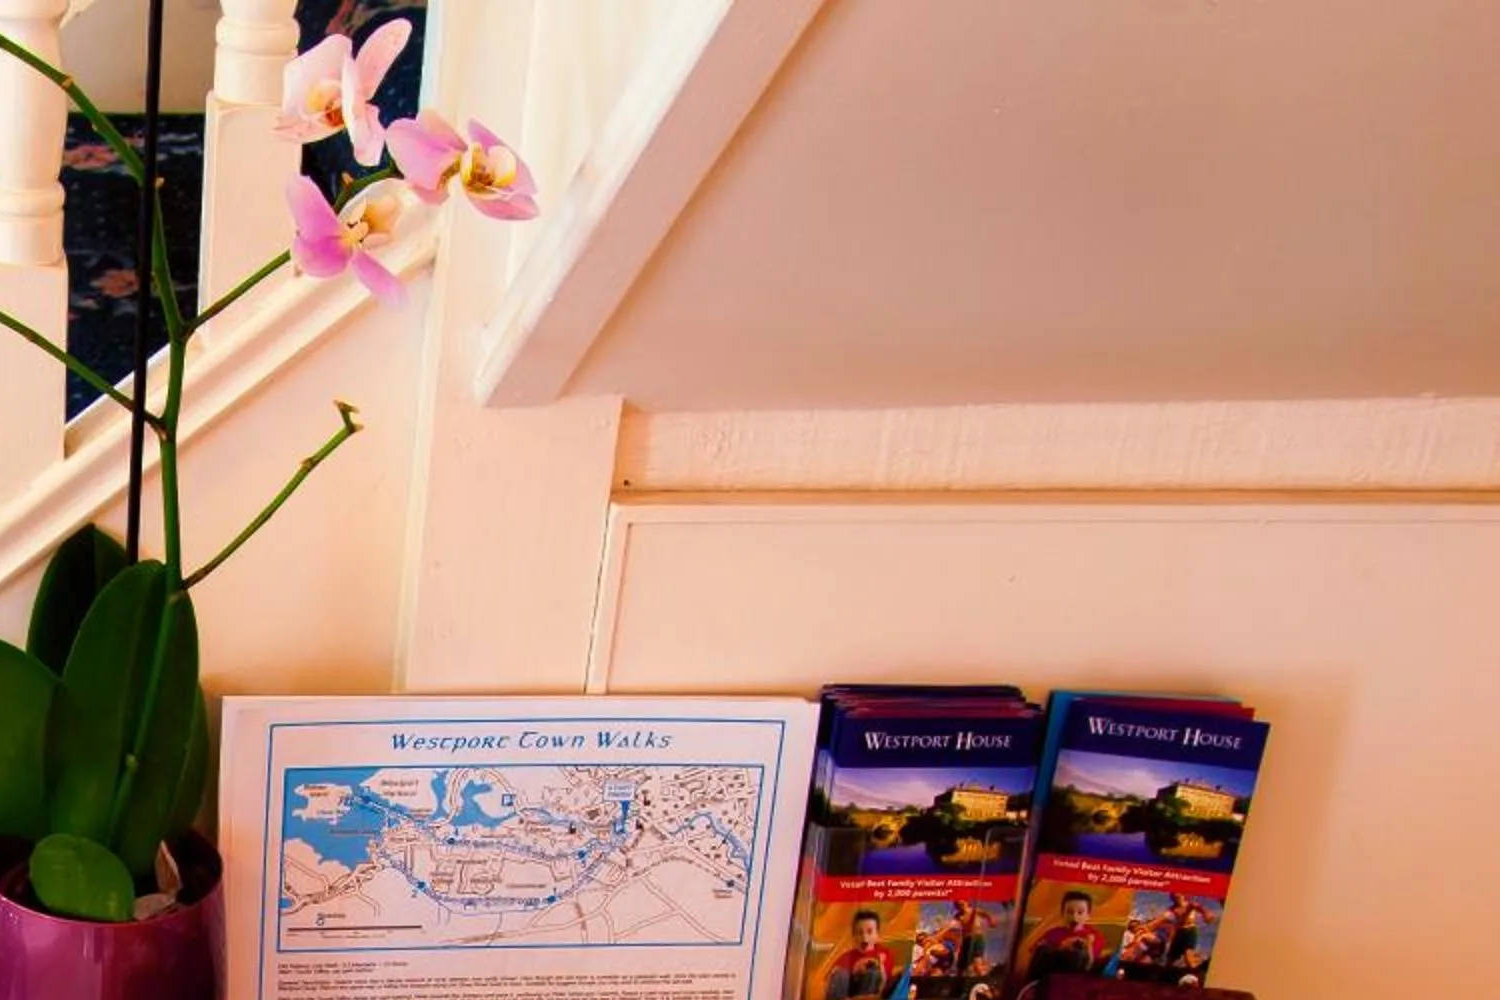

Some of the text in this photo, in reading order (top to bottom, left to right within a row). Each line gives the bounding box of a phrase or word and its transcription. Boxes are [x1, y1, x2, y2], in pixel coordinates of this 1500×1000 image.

[1088, 716, 1243, 749] WESTPORT HOUSE
[392, 730, 672, 754] Westport Town Walks
[864, 731, 1012, 750] WESTPORT HOUSE
[1081, 861, 1100, 871] Best
[1102, 863, 1131, 875] Family
[867, 879, 885, 888] Best
[887, 880, 914, 889] Family
[1088, 873, 1098, 882] by
[874, 890, 884, 899] by
